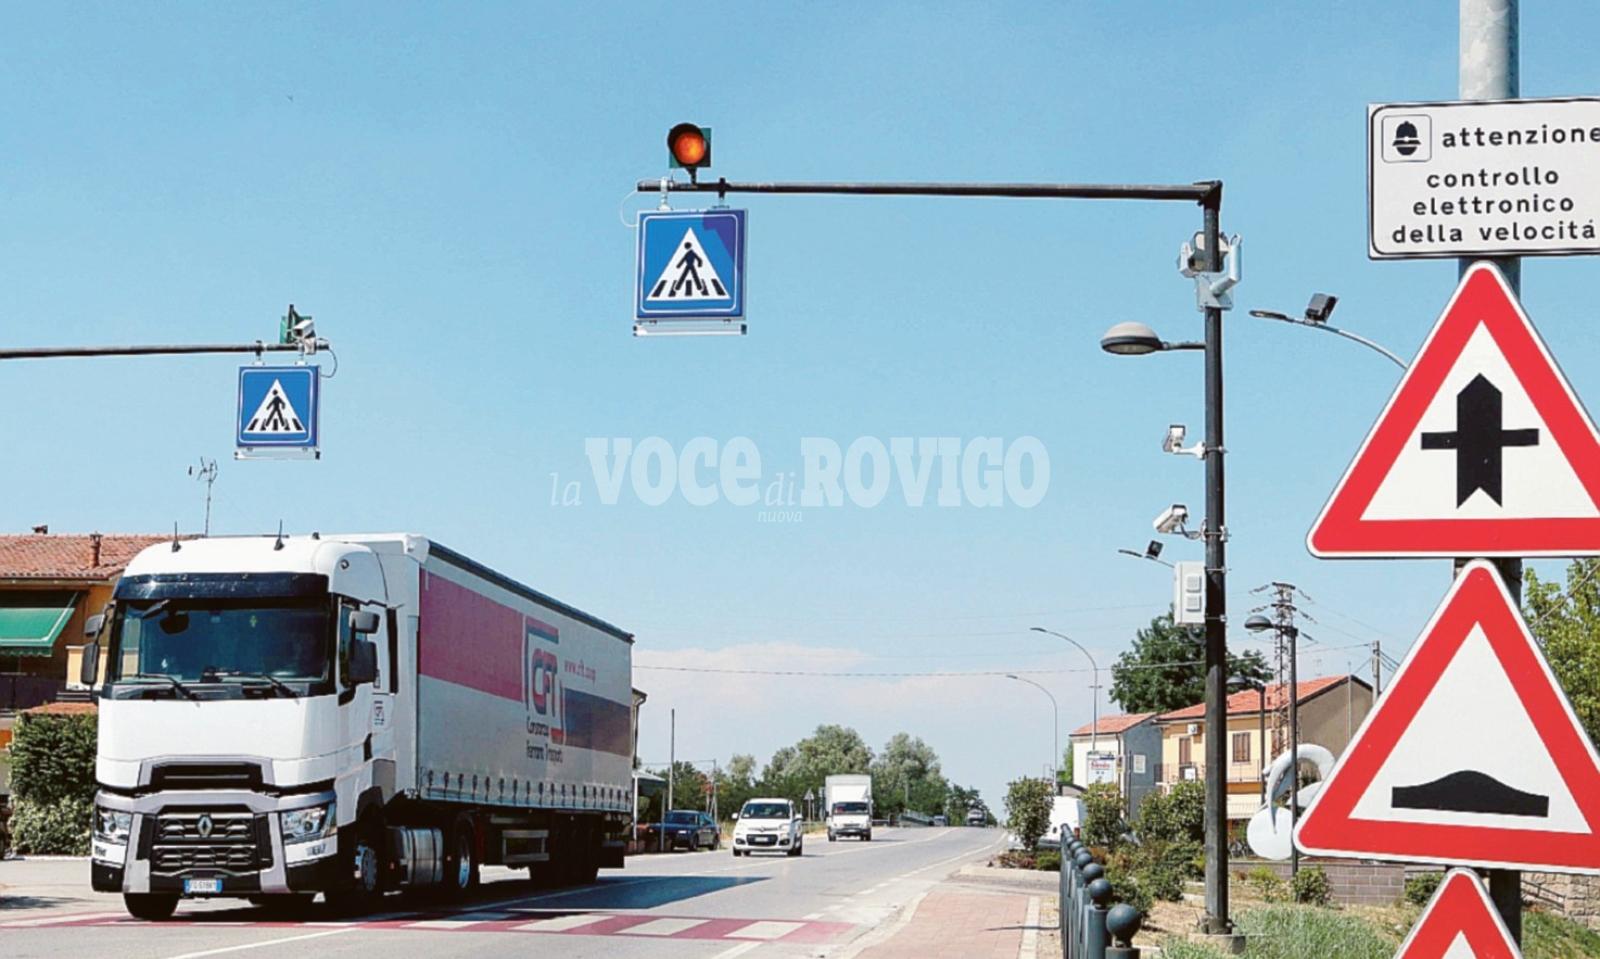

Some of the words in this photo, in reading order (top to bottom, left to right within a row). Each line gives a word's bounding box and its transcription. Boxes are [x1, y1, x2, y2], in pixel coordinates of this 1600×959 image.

[1442, 124, 1600, 148] attenzione
[1426, 166, 1559, 188] controllo
[1413, 194, 1574, 216] elettronico
[1392, 225, 1463, 243] della
[532, 649, 557, 717] CFT
